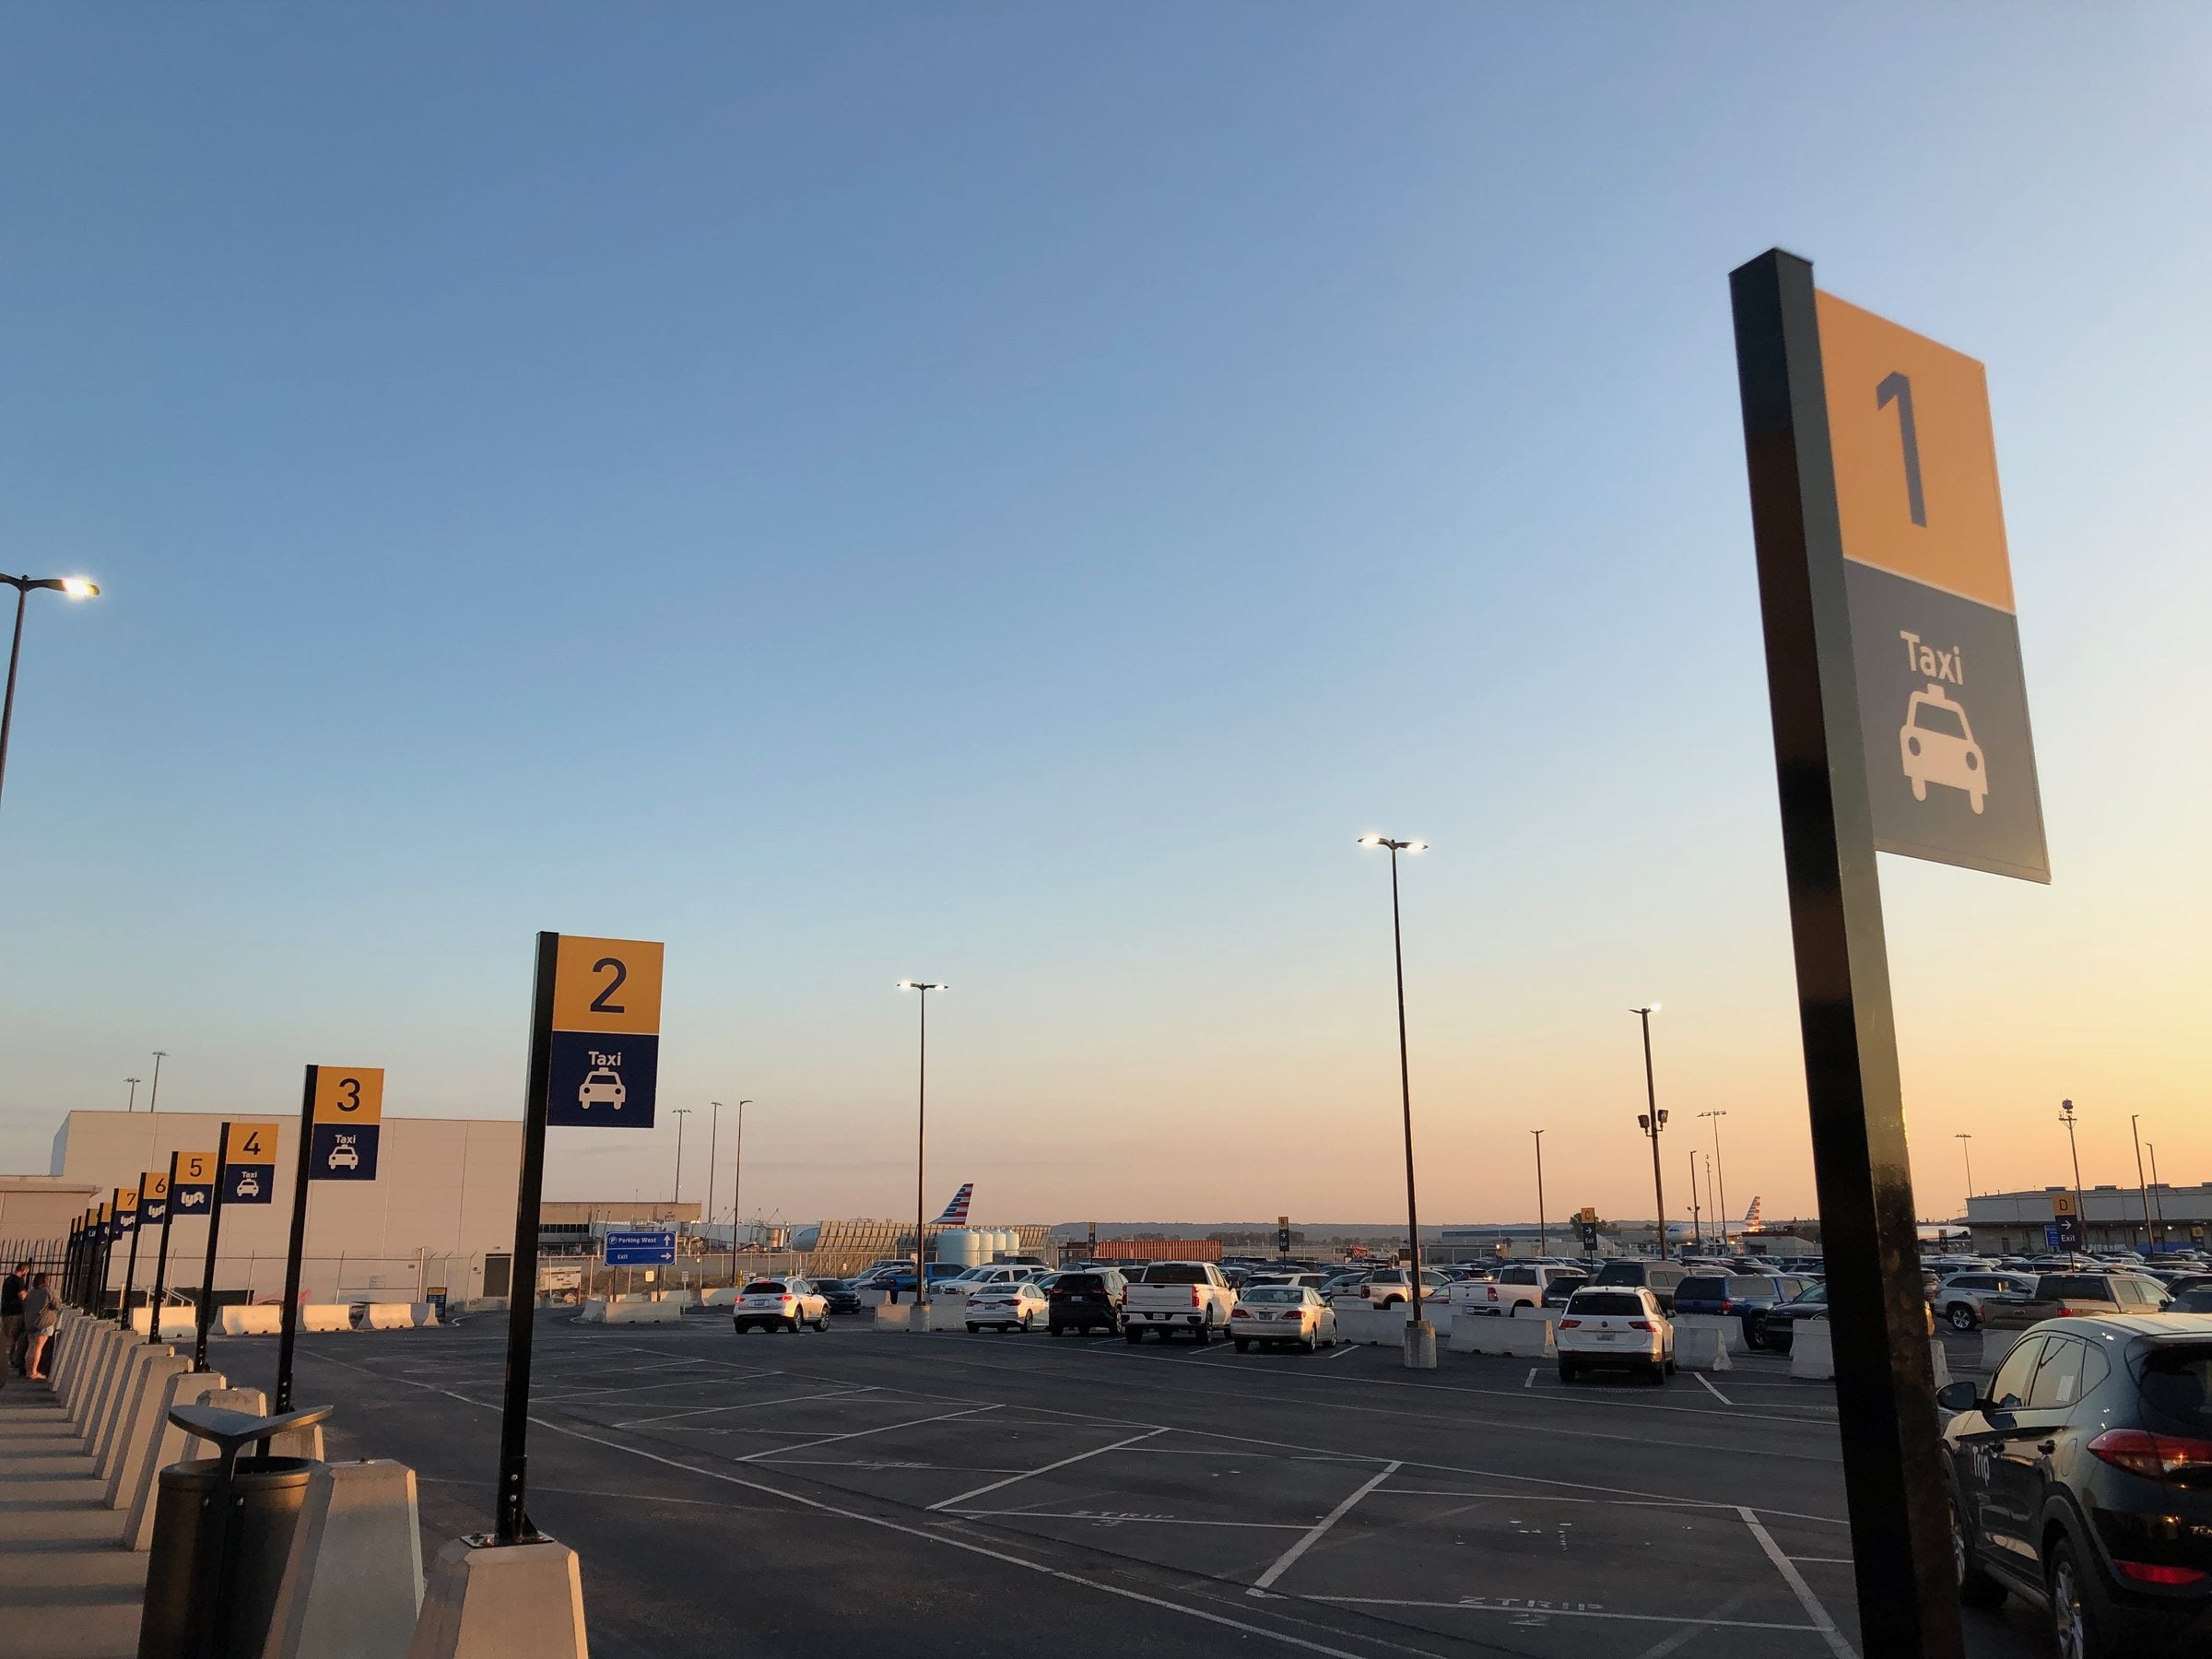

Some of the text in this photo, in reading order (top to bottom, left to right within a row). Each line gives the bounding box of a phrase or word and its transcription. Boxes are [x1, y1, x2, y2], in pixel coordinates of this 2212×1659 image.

[1876, 371, 1927, 528] 1
[1900, 629, 1963, 686] Taxi
[590, 958, 627, 1013] 2
[588, 1051, 622, 1066] Taxi
[336, 1077, 360, 1112] 3
[242, 1131, 262, 1156] 4
[335, 1135, 357, 1144] Taxi
[189, 1158, 203, 1178] 5
[155, 1177, 166, 1194] 6
[126, 1193, 137, 1206] 7
[2059, 1199, 2068, 1211] D
[2061, 1234, 2077, 1243] Exit
[1458, 1595, 1604, 1611] ZTRIP
